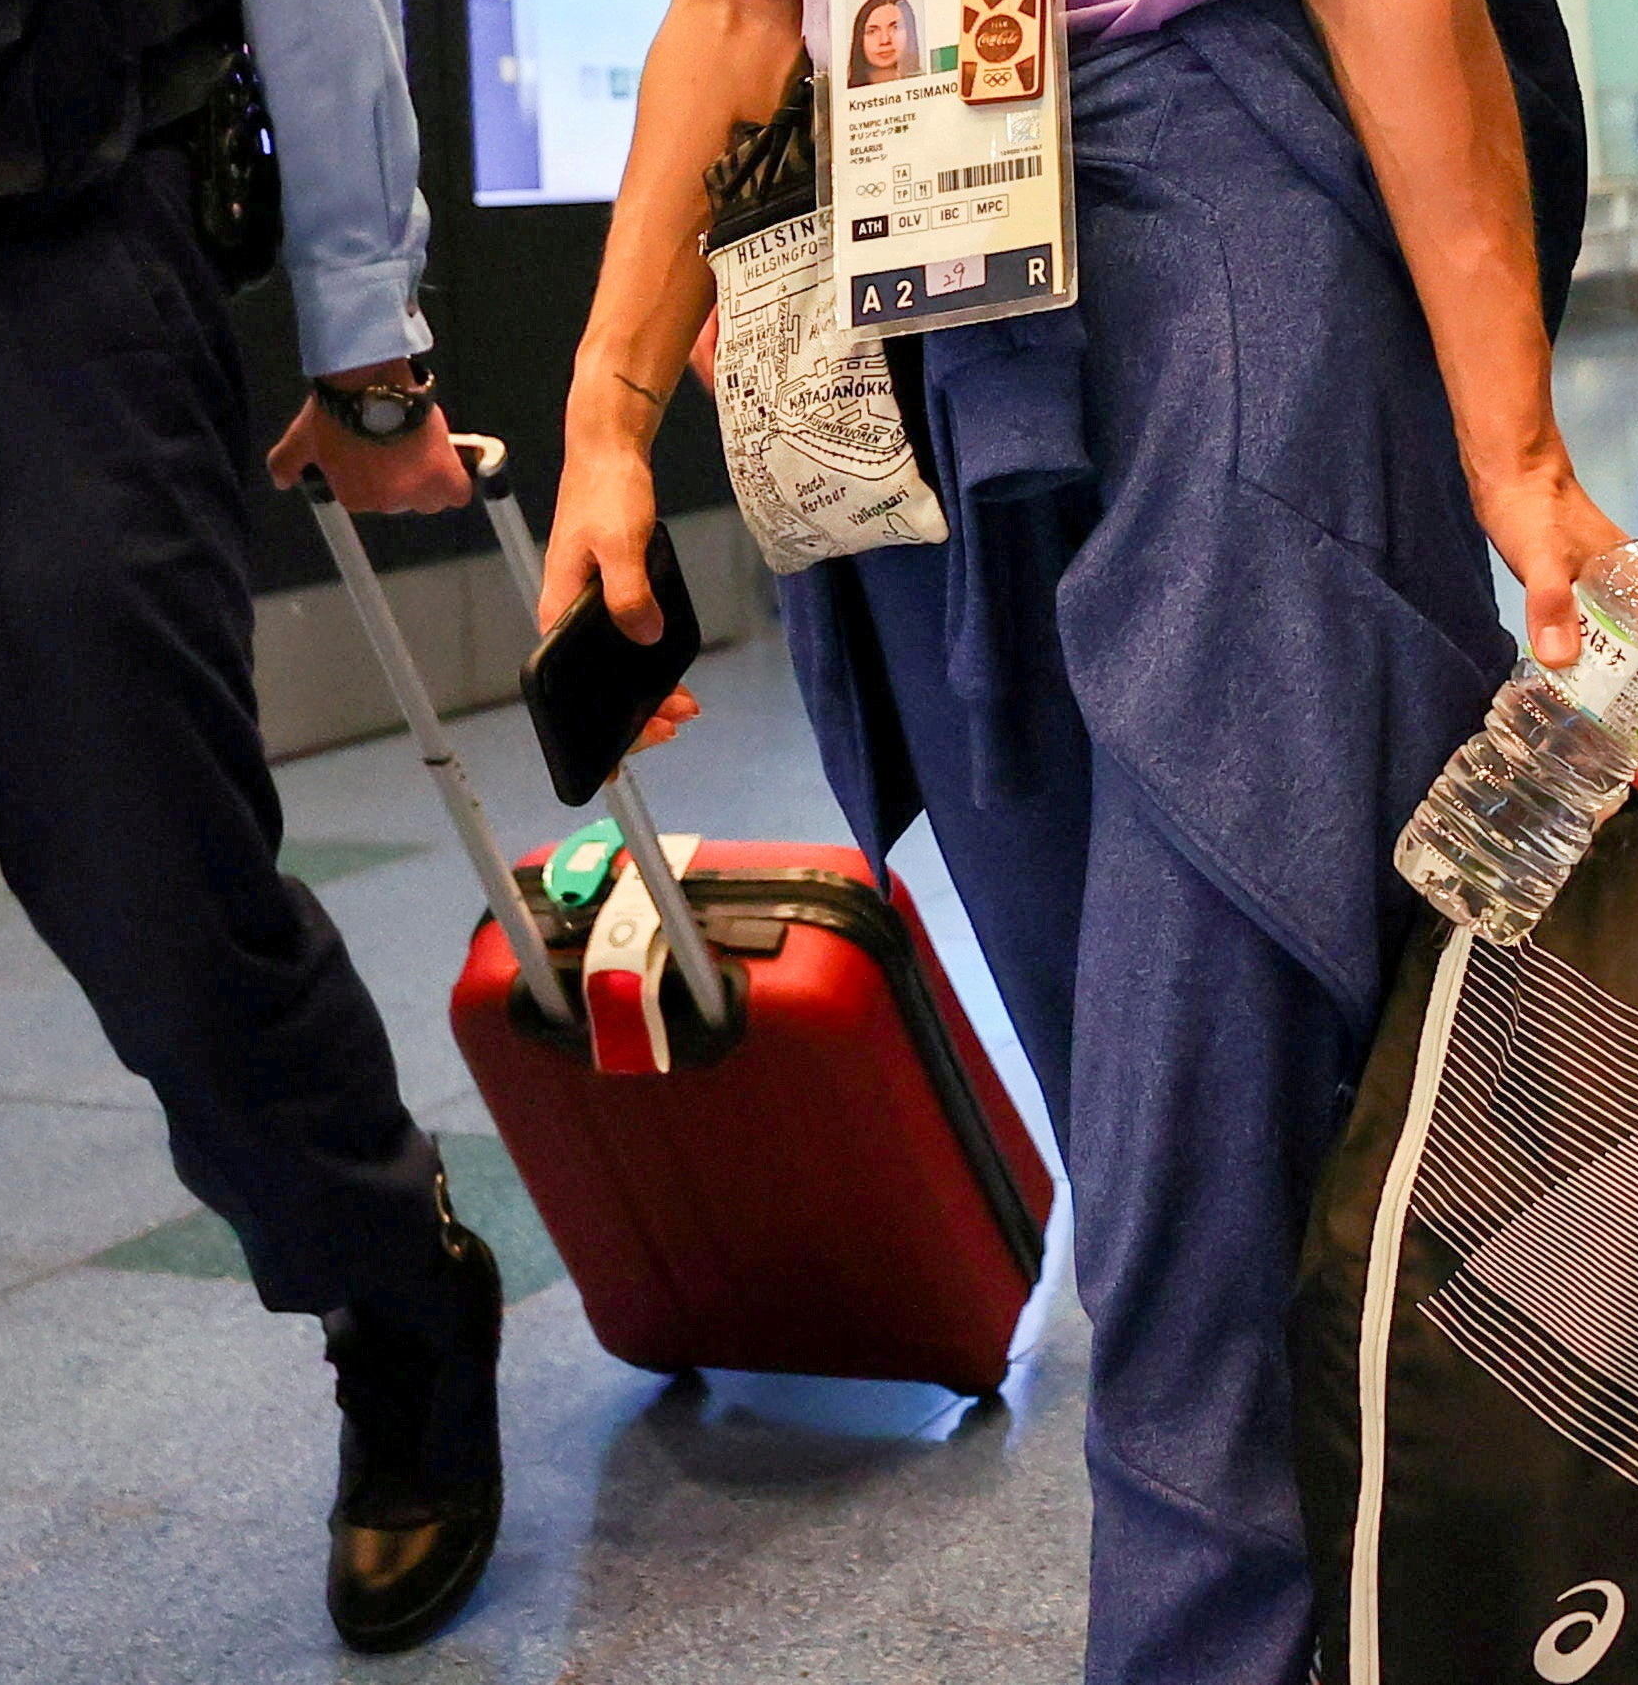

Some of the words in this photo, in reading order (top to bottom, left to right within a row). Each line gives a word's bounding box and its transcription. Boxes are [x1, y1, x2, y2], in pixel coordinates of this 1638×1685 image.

[848, 93, 902, 112] Krystsina
[848, 119, 882, 132] OLYMPIC
[884, 112, 916, 125] ATHLETE
[849, 143, 883, 156] BELARUS
[896, 169, 908, 179] TA
[897, 189, 909, 200] TP
[940, 206, 960, 221] IBC
[976, 198, 1003, 216] MPC
[857, 219, 884, 237] ATH
[898, 213, 922, 229] OLV
[1028, 258, 1046, 285] R
[862, 285, 881, 315] A
[896, 280, 914, 310] 2
[795, 472, 826, 498] South
[799, 486, 847, 515] Harbour
